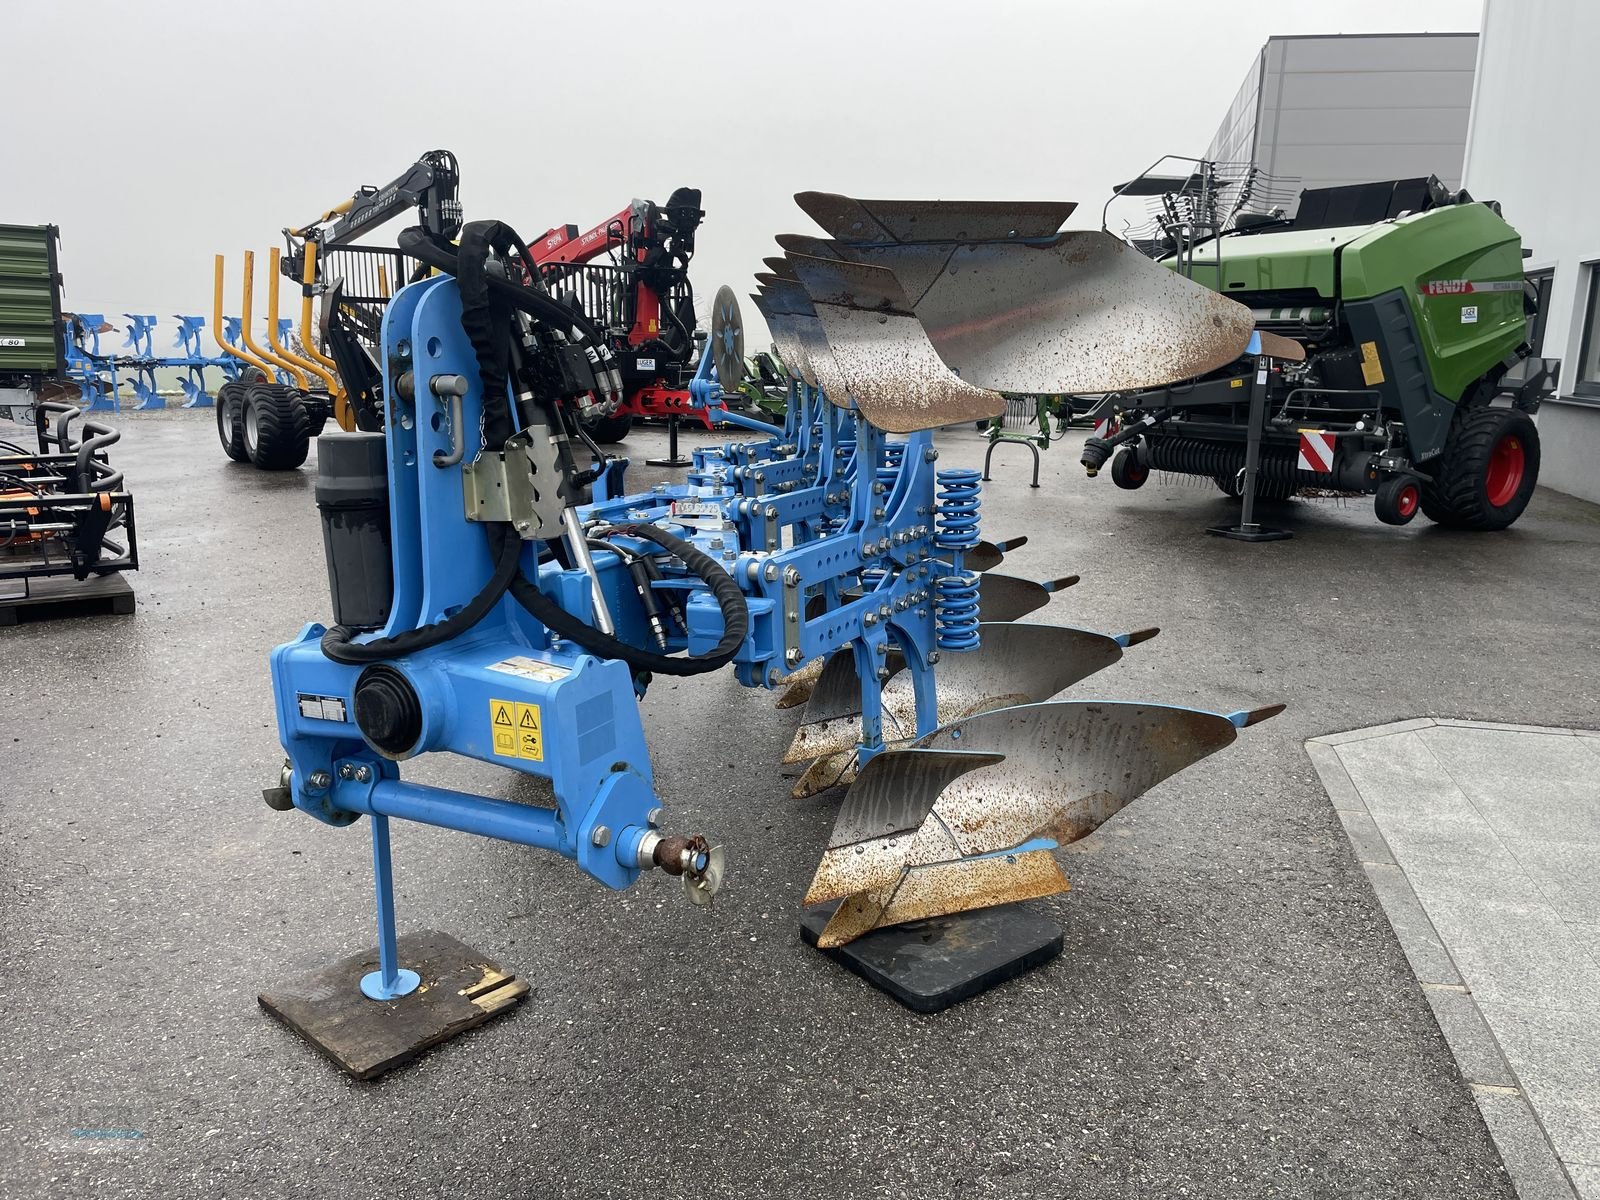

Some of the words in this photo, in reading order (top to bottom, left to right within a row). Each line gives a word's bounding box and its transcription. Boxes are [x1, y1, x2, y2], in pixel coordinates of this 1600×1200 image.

[1428, 280, 1468, 294] FENDT
[587, 350, 597, 361] M
[600, 347, 609, 358] S
